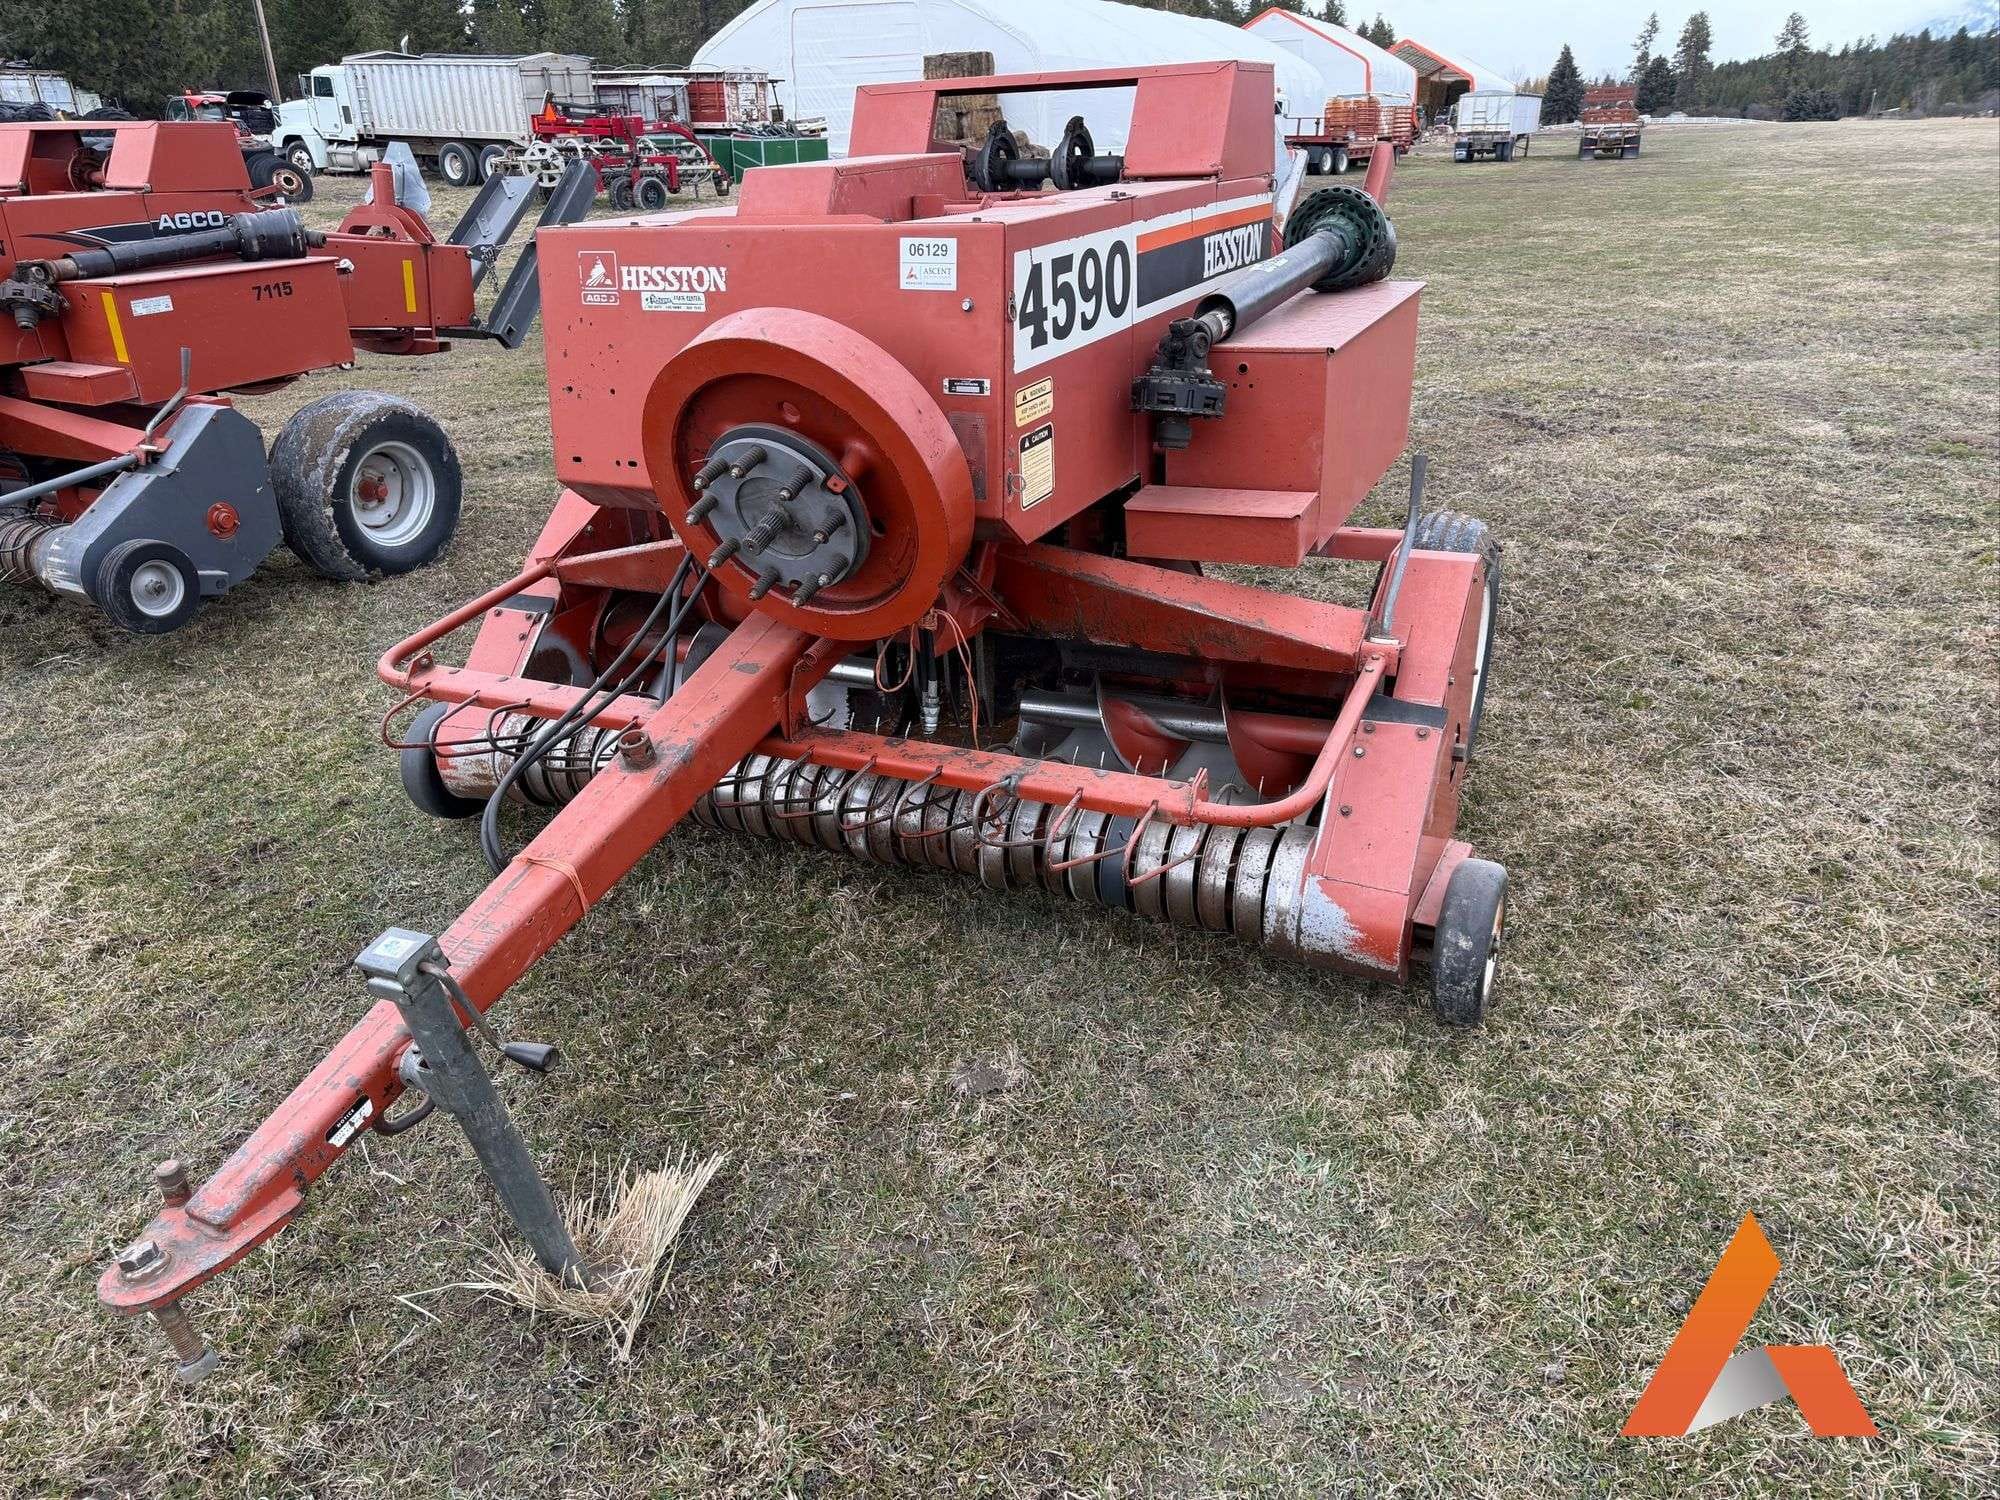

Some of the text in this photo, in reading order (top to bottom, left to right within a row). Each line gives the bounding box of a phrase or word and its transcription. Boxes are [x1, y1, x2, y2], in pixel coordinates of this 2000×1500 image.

[158, 210, 225, 231] AGCO
[909, 243, 949, 257] 06129
[1202, 222, 1264, 280] HESSTON
[620, 264, 727, 292] HESSTON
[924, 267, 952, 275] ASCENT
[252, 281, 294, 301] 7115
[1018, 239, 1132, 351] 4590
[1031, 429, 1049, 443] CAUTION
[336, 1109, 355, 1128] NOTICE
